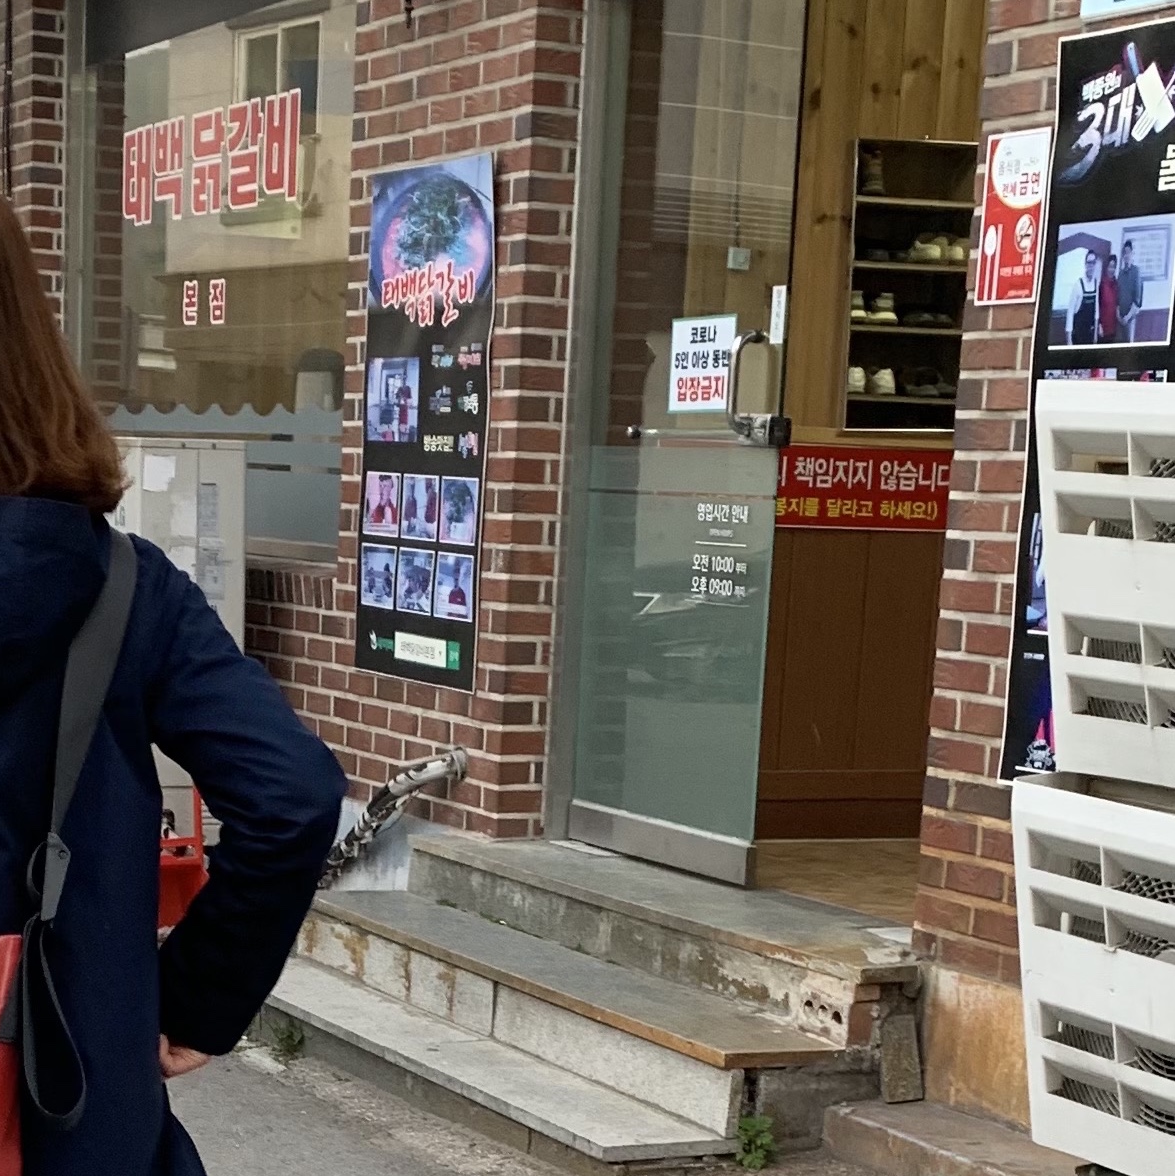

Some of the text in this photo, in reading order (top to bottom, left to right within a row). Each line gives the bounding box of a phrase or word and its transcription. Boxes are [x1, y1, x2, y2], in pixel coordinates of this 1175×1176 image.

[123, 88, 302, 227] 태백 닭갈비
[690, 325, 717, 344] 코로나
[674, 351, 689, 370] 5인
[691, 350, 710, 370] 이상
[677, 375, 725, 402] 입장금지
[794, 456, 874, 490] 책임지지
[697, 503, 749, 523] 영업시간 안내
[826, 498, 873, 518] 달라고
[692, 554, 710, 572] 오전
[711, 555, 735, 574] 10:00
[691, 576, 708, 595] 오후
[708, 578, 733, 597] 09:00
